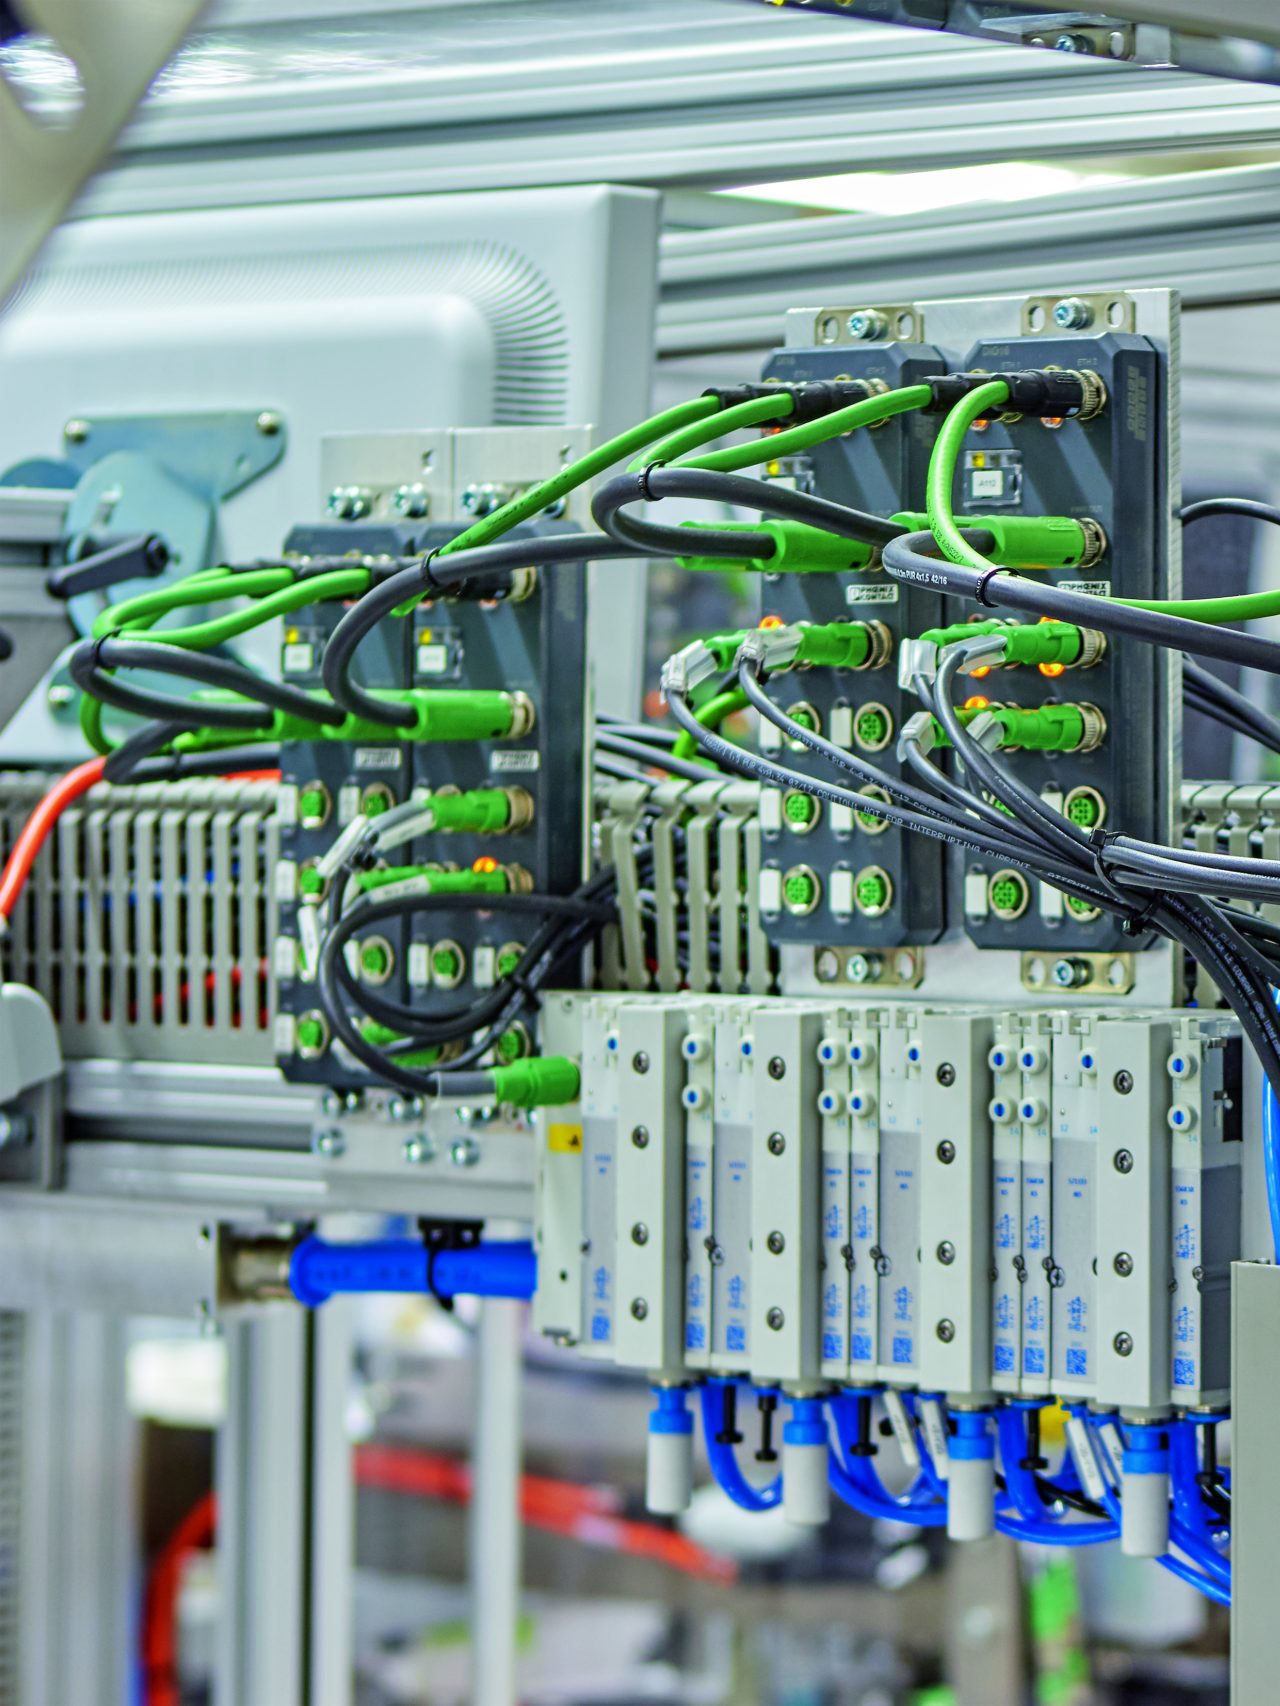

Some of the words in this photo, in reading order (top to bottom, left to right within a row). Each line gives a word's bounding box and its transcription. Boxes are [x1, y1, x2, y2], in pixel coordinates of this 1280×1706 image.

[930, 574, 948, 586] 42/16
[864, 805, 882, 818] NOT
[886, 813, 904, 826] FOR
[909, 821, 981, 853] INTERRUPTING
[985, 849, 1031, 871] CURRENT
